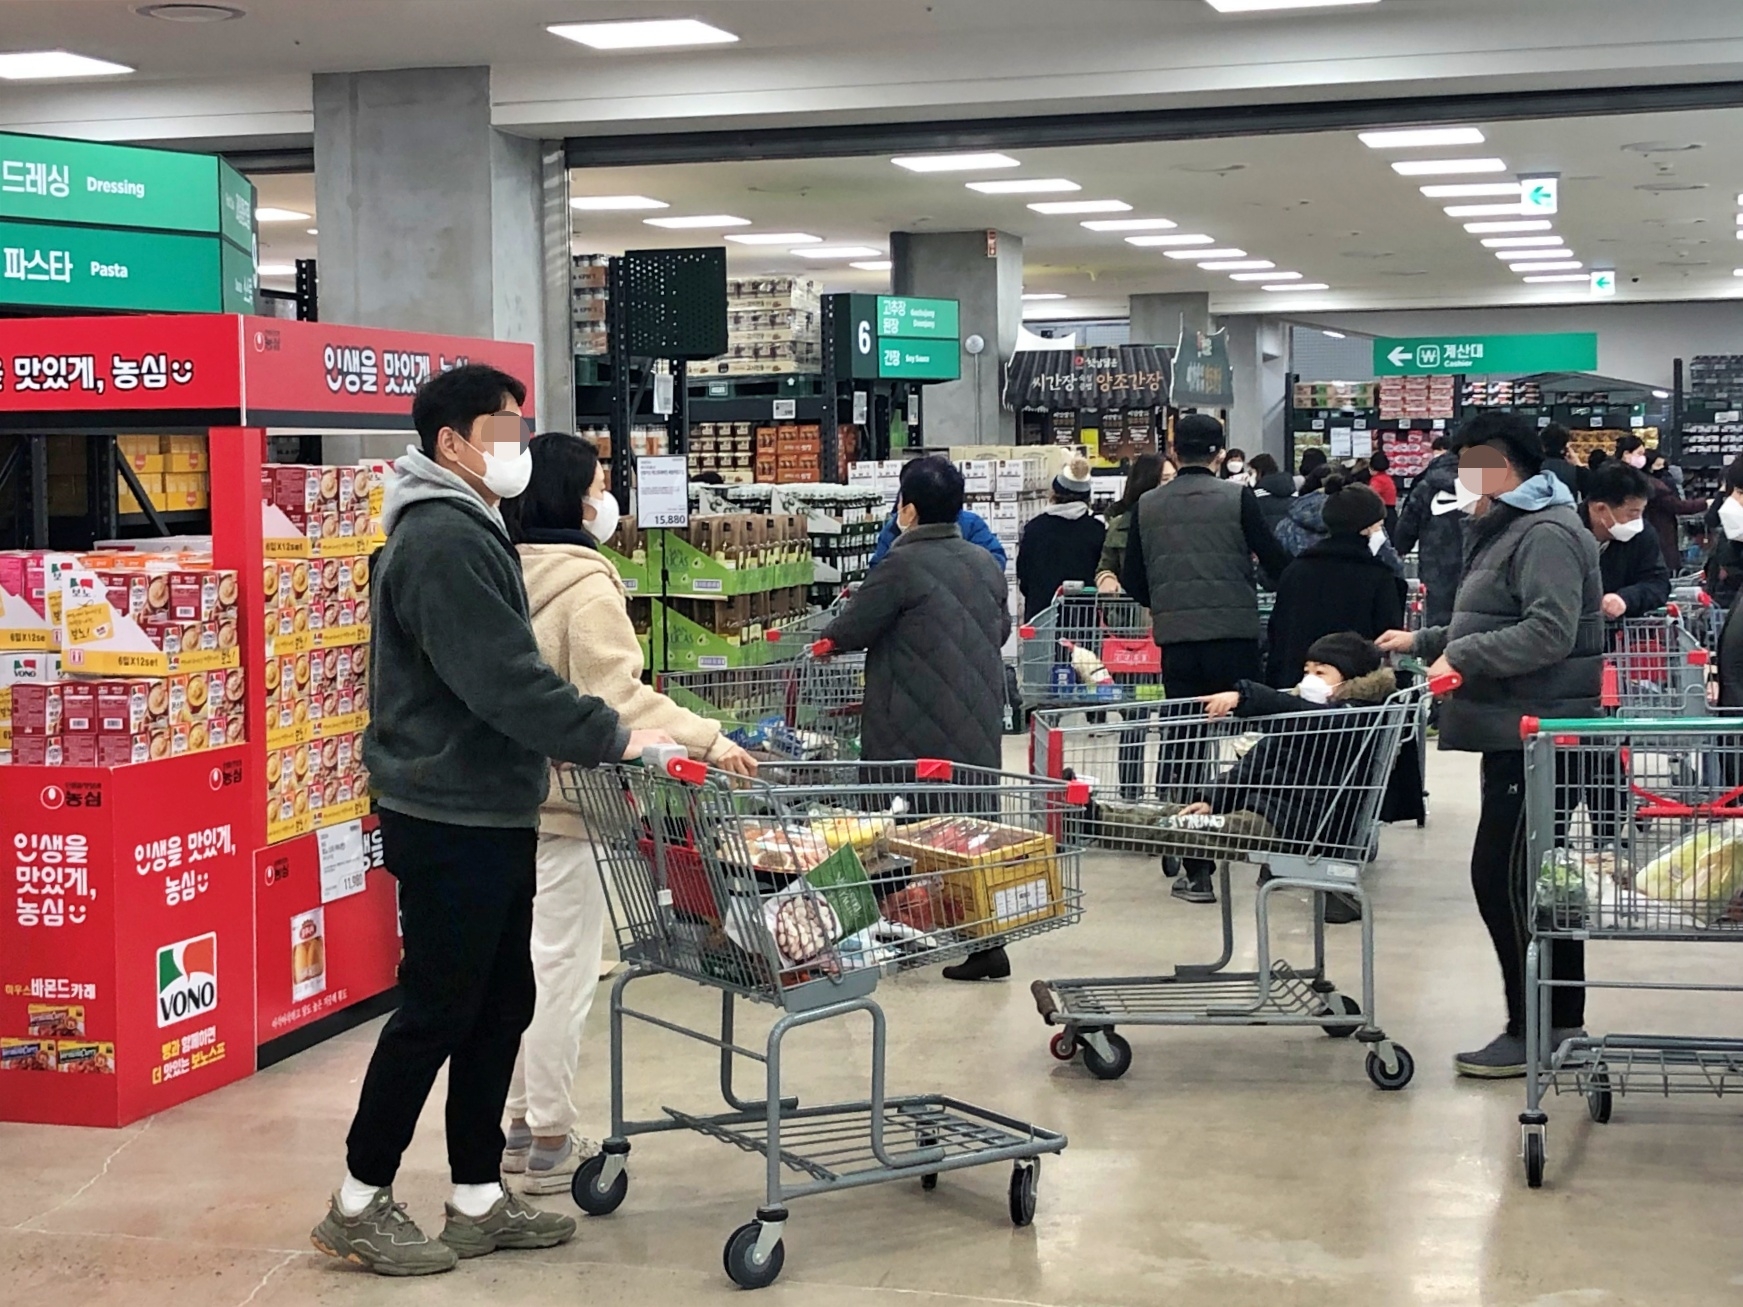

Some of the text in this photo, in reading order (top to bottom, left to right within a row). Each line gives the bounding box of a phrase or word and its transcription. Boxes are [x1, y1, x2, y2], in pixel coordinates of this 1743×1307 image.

[2, 160, 145, 198] 드레싱 Dressing
[3, 248, 128, 283] 파스타 Pasta
[883, 300, 906, 316] 고추장
[858, 320, 871, 354] 6
[883, 318, 899, 334] 된장
[884, 350, 900, 366] 간장
[1443, 344, 1484, 359] 계산대
[13, 356, 105, 394] 맛있게,
[112, 354, 168, 389] 농심
[324, 344, 378, 393] 인생을
[1032, 373, 1078, 392] 씨간장
[1096, 371, 1164, 392] 양조간장
[655, 515, 686, 525] 15,880
[118, 656, 159, 667] 6입X12set
[65, 791, 101, 807] 농심
[14, 833, 88, 863] 인생을
[134, 824, 236, 875] 인생을 맛있게,
[16, 867, 97, 900] 맛있게,
[165, 870, 195, 906] 농심
[16, 898, 64, 926] 농심
[160, 982, 215, 1021] VONO
[152, 1041, 226, 1085] 더 맛있는 보노스프
